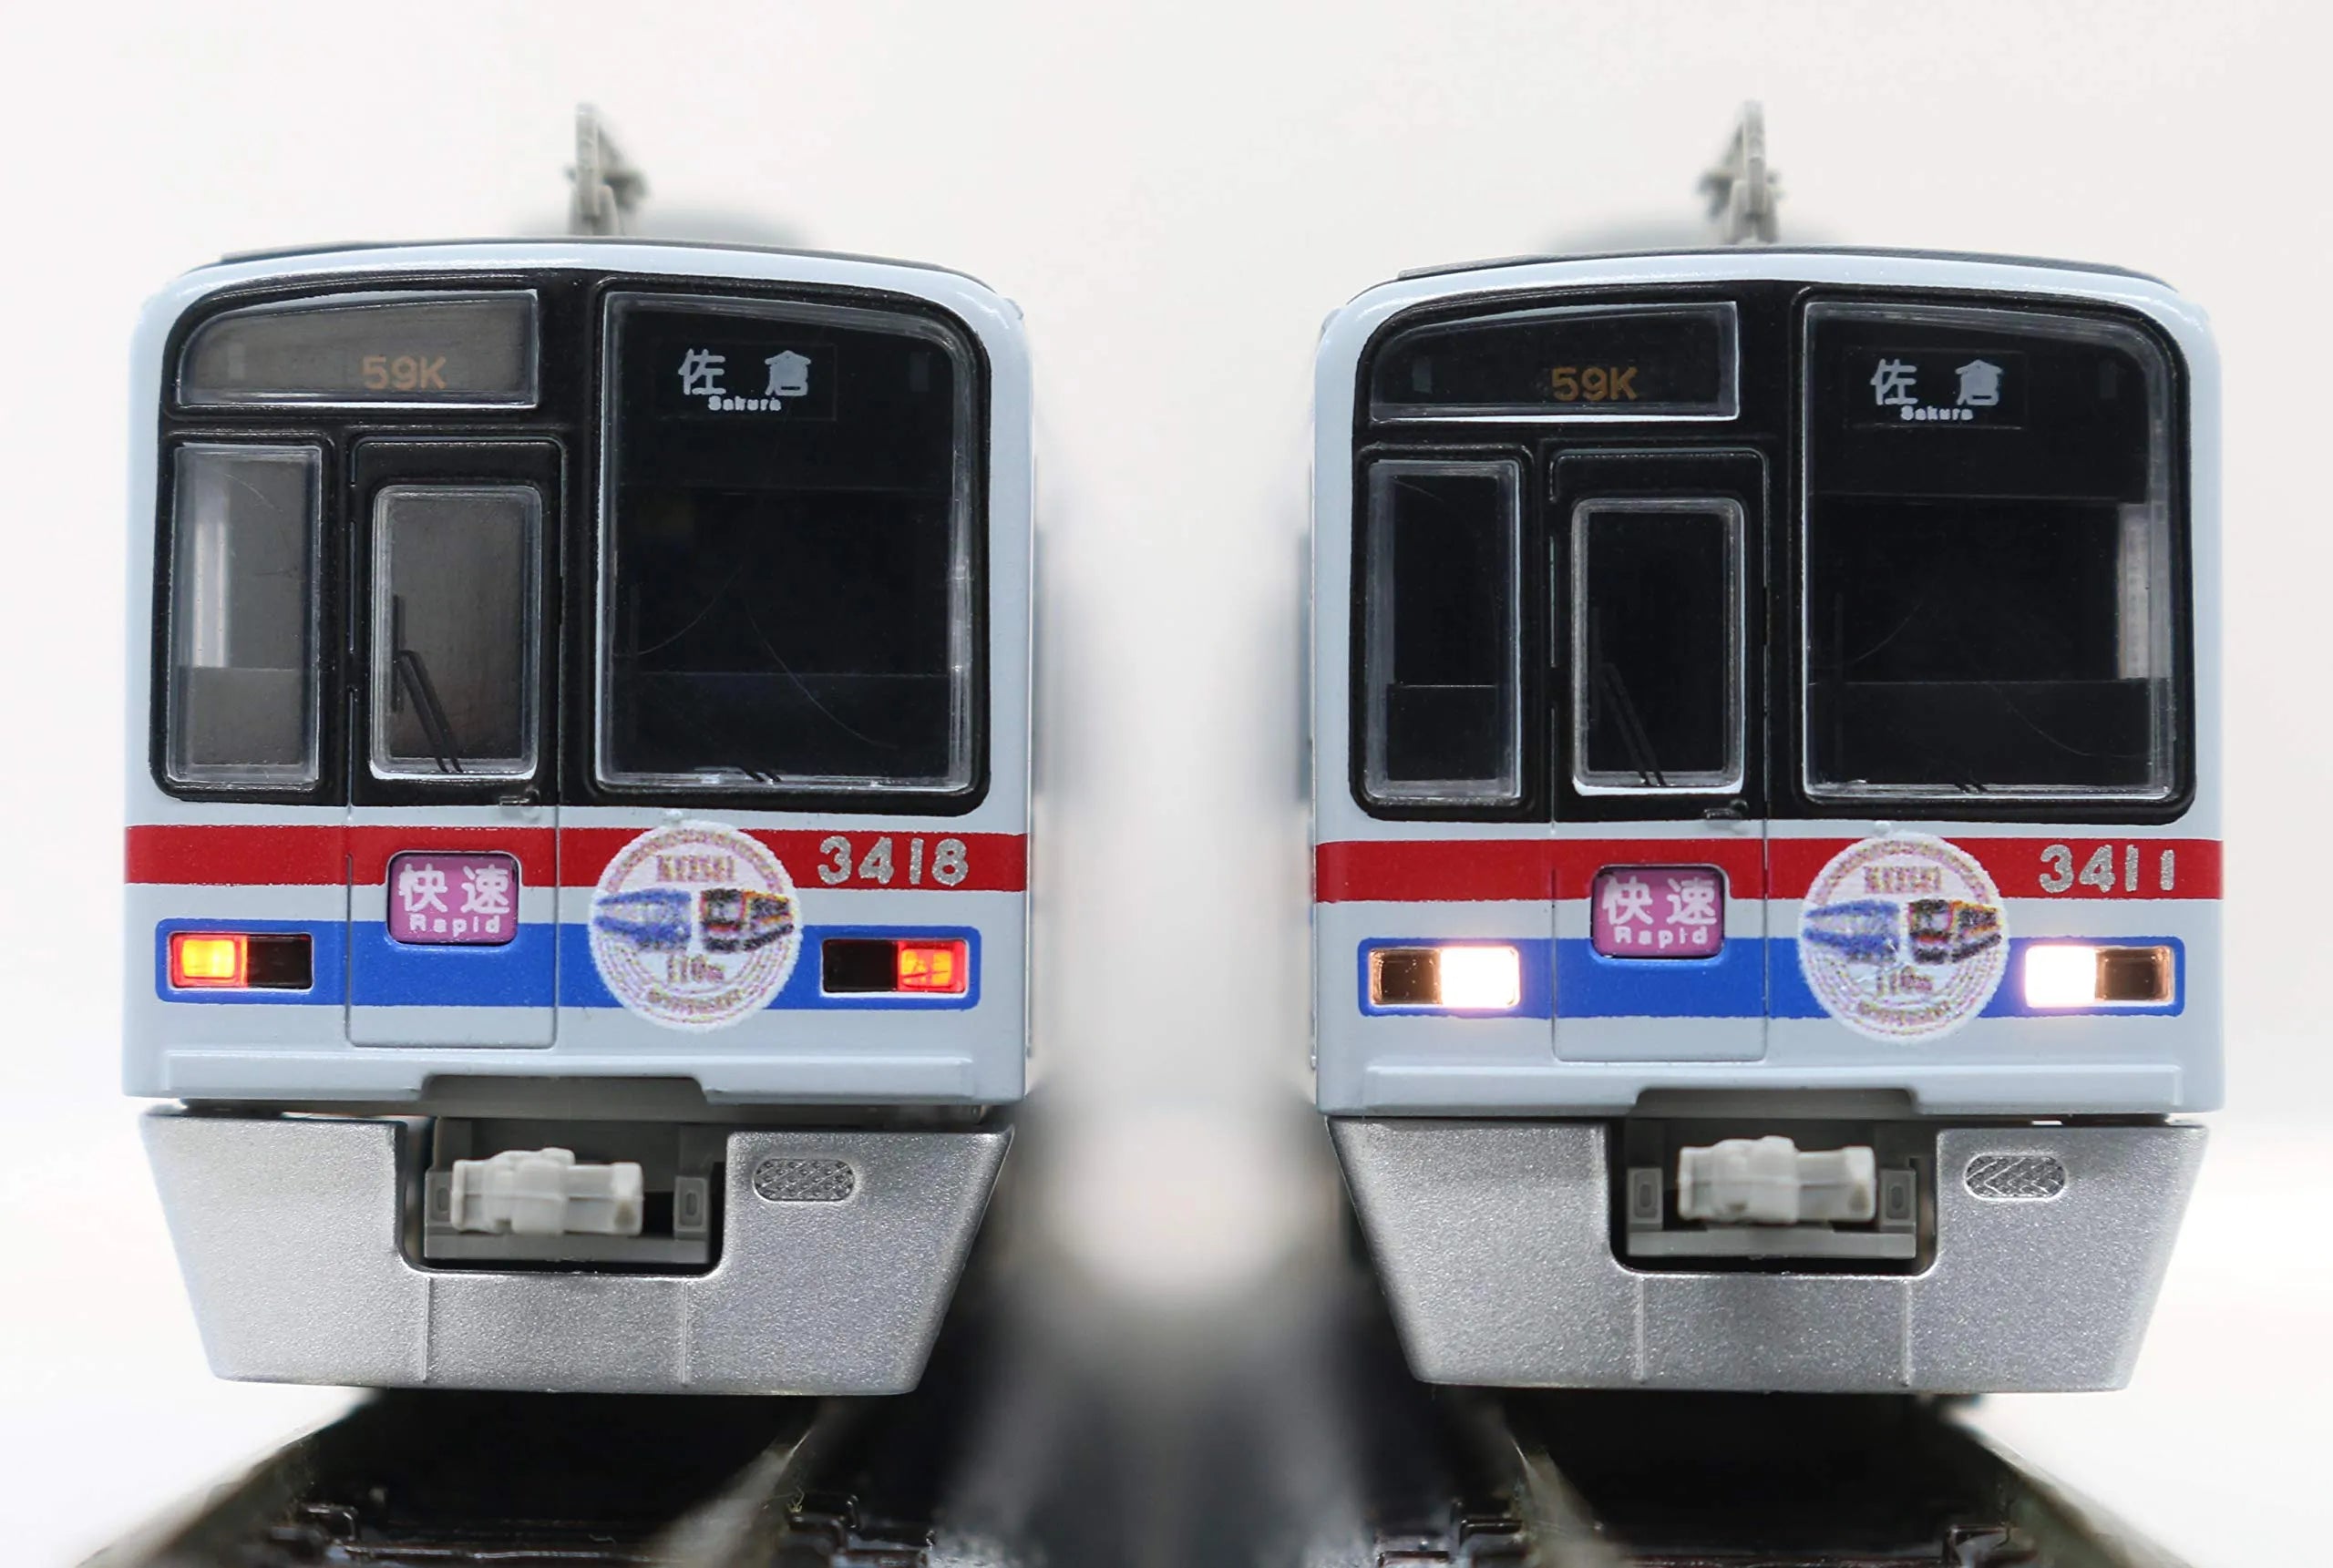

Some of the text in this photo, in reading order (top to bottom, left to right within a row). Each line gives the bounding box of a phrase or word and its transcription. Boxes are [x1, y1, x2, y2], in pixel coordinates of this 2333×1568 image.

[363, 354, 447, 390] 59K
[1552, 366, 1638, 401] 59K
[817, 835, 969, 886] 3418
[2040, 845, 2175, 893] 3411
[398, 864, 510, 914] 快速
[1602, 876, 1717, 925] 快速
[410, 913, 500, 938] Rapid
[1614, 926, 1709, 949] Rapid
